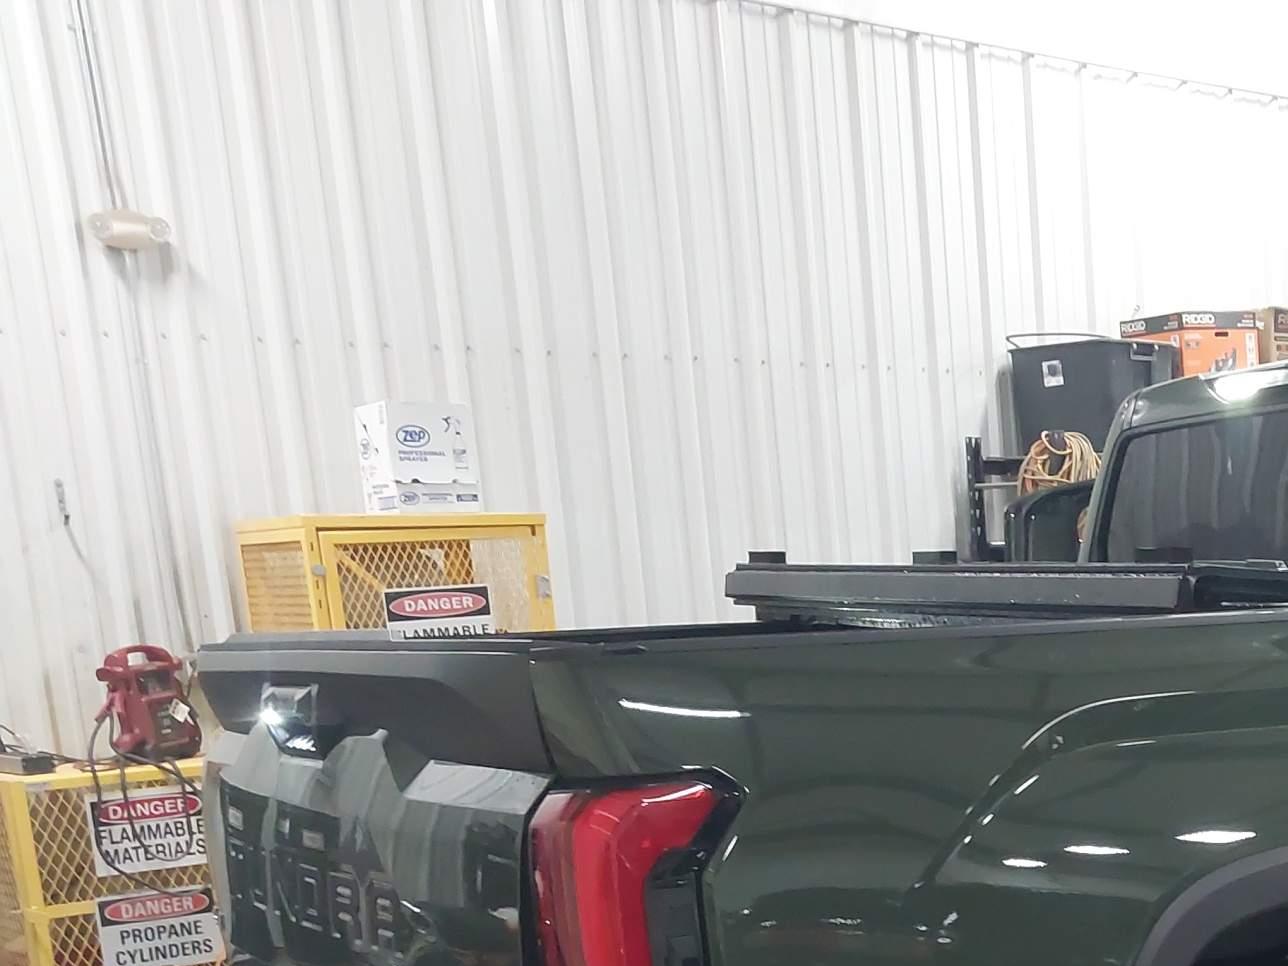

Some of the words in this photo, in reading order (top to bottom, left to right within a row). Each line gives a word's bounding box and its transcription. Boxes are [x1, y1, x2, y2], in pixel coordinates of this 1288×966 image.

[1120, 320, 1146, 333] RIDGID
[1181, 313, 1215, 325] RIDGID
[404, 596, 474, 612] DANGER
[396, 623, 489, 640] LAMMABLE
[105, 838, 206, 866] MATERIALS
[120, 896, 193, 919] DANGER
[120, 919, 204, 946] PROPANE
[116, 938, 213, 966] CYLINDERS
